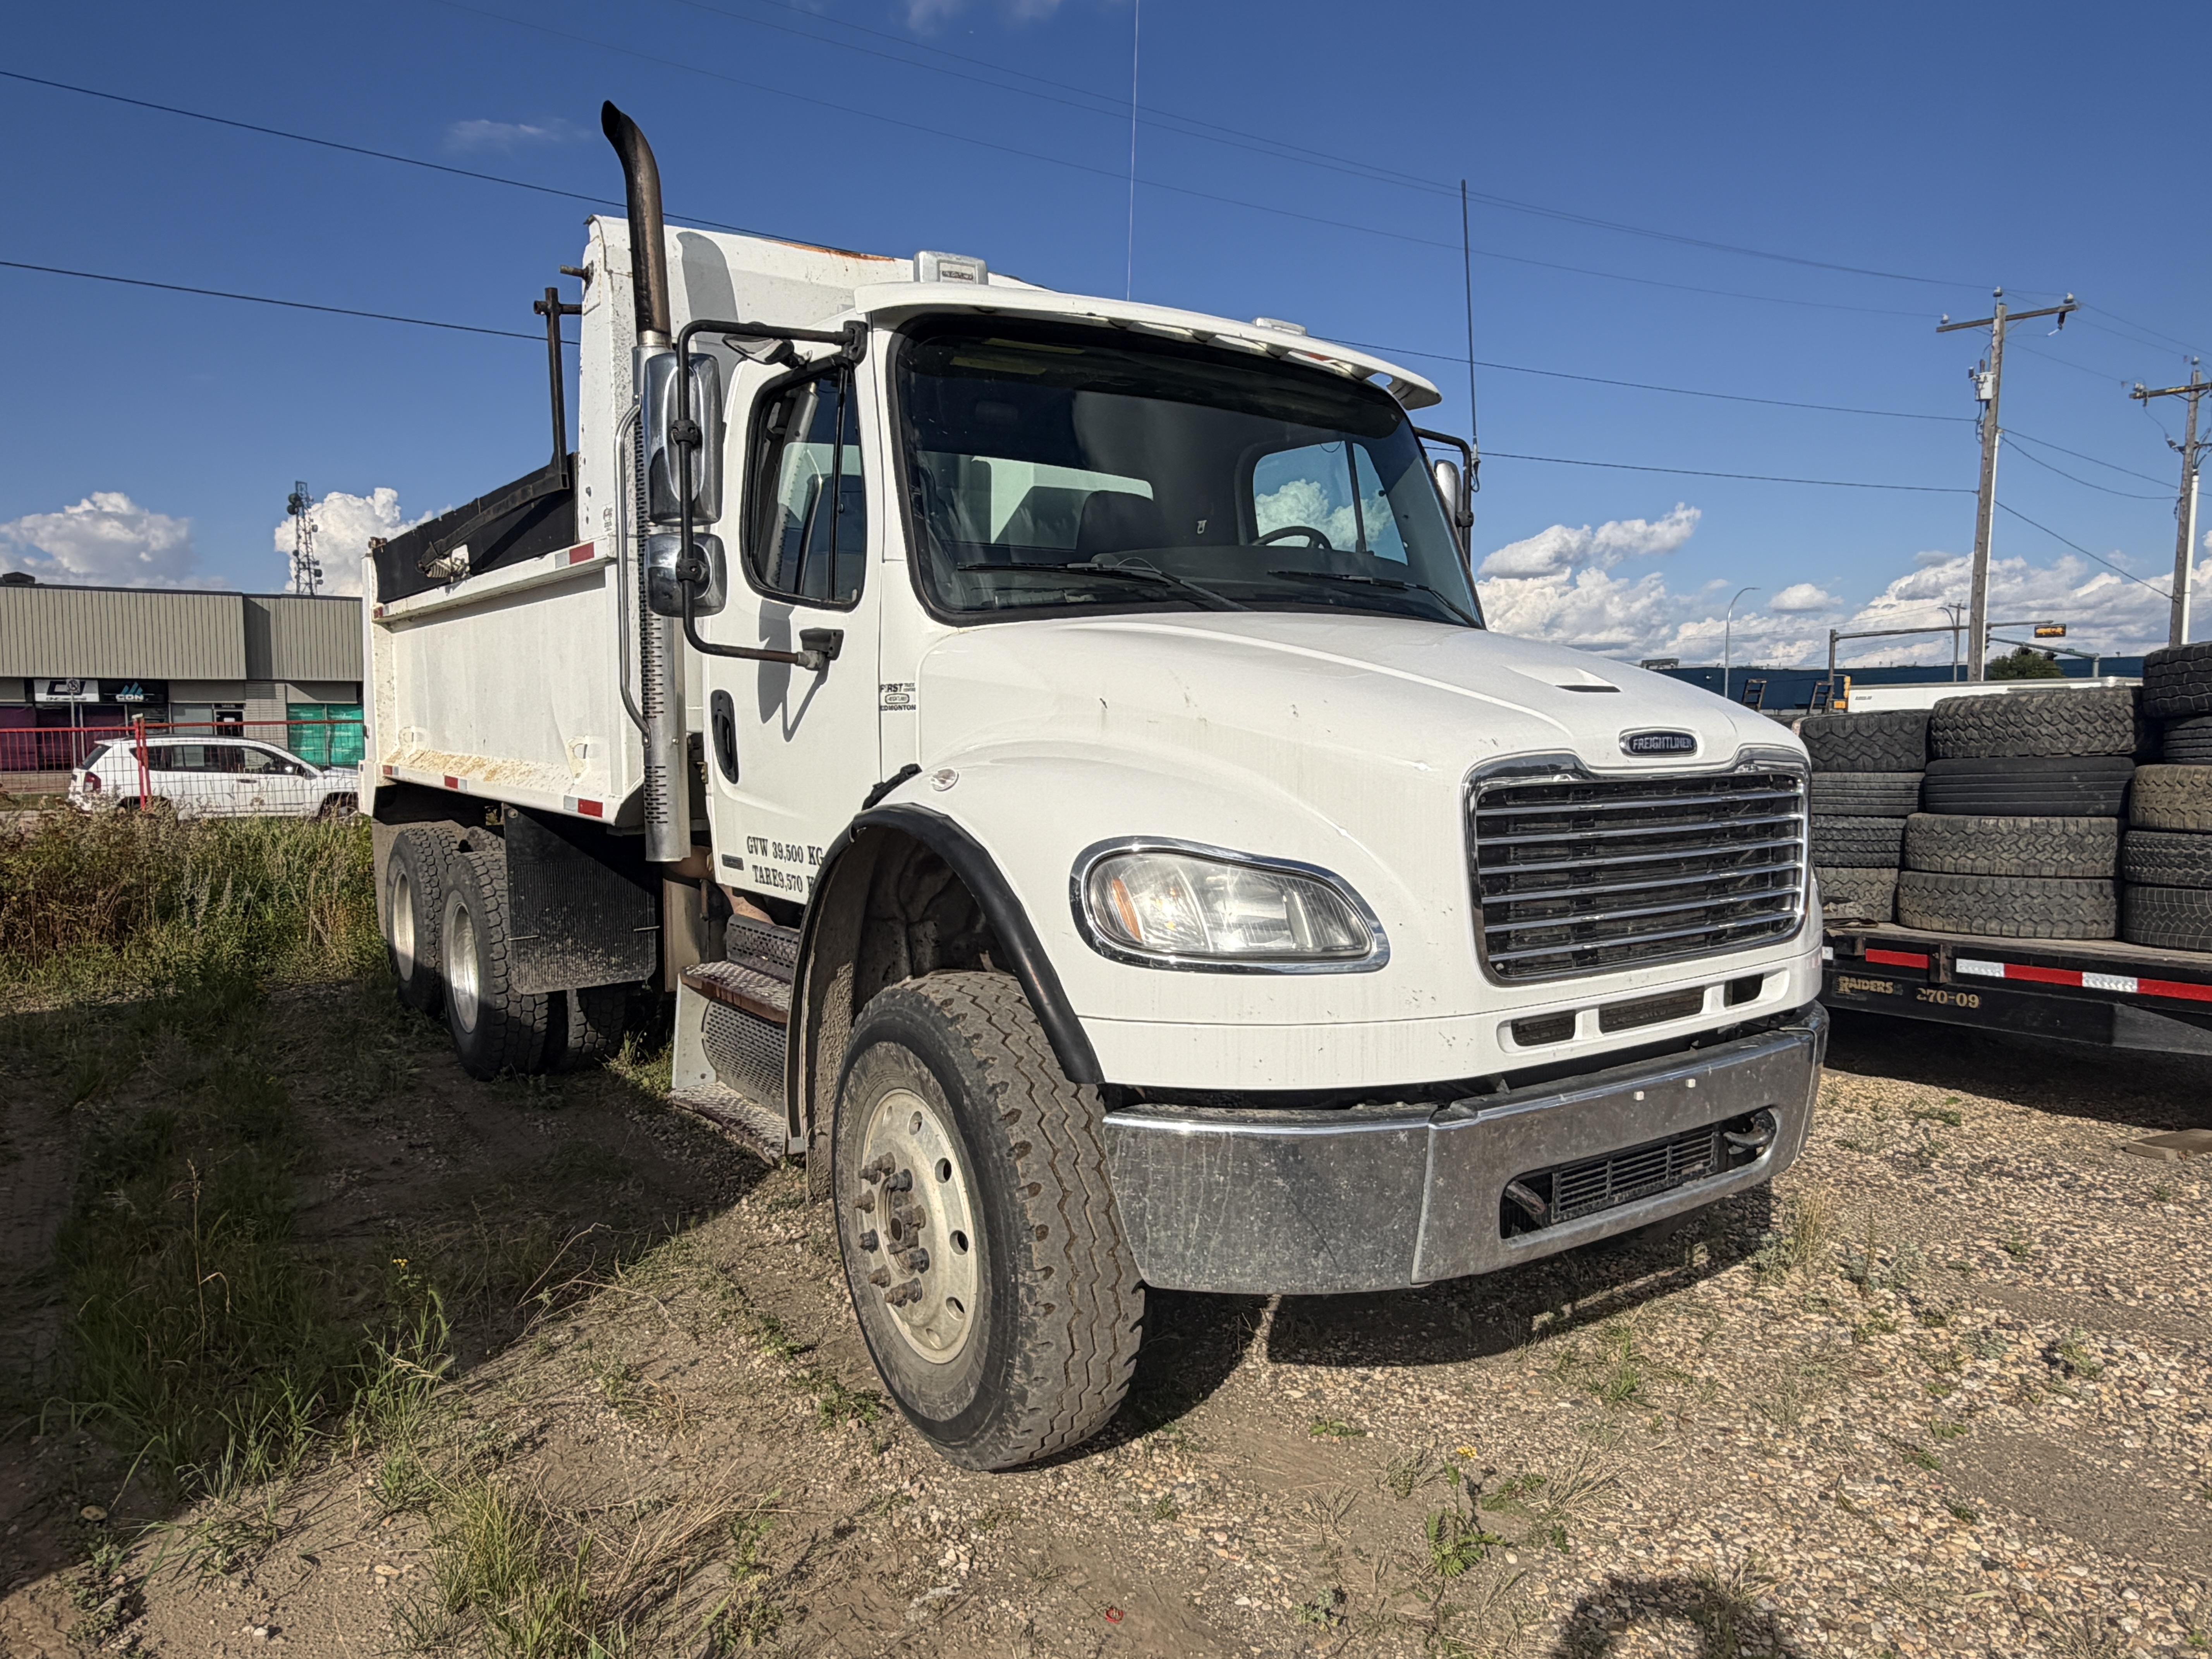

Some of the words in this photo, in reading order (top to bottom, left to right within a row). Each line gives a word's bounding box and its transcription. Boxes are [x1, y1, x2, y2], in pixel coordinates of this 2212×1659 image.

[1633, 737, 1693, 750] FREIGHTLINER
[747, 836, 768, 857] GVW
[772, 841, 804, 863] 39,500
[807, 845, 825, 866] KG
[1917, 988, 1980, 1008] 270-09
